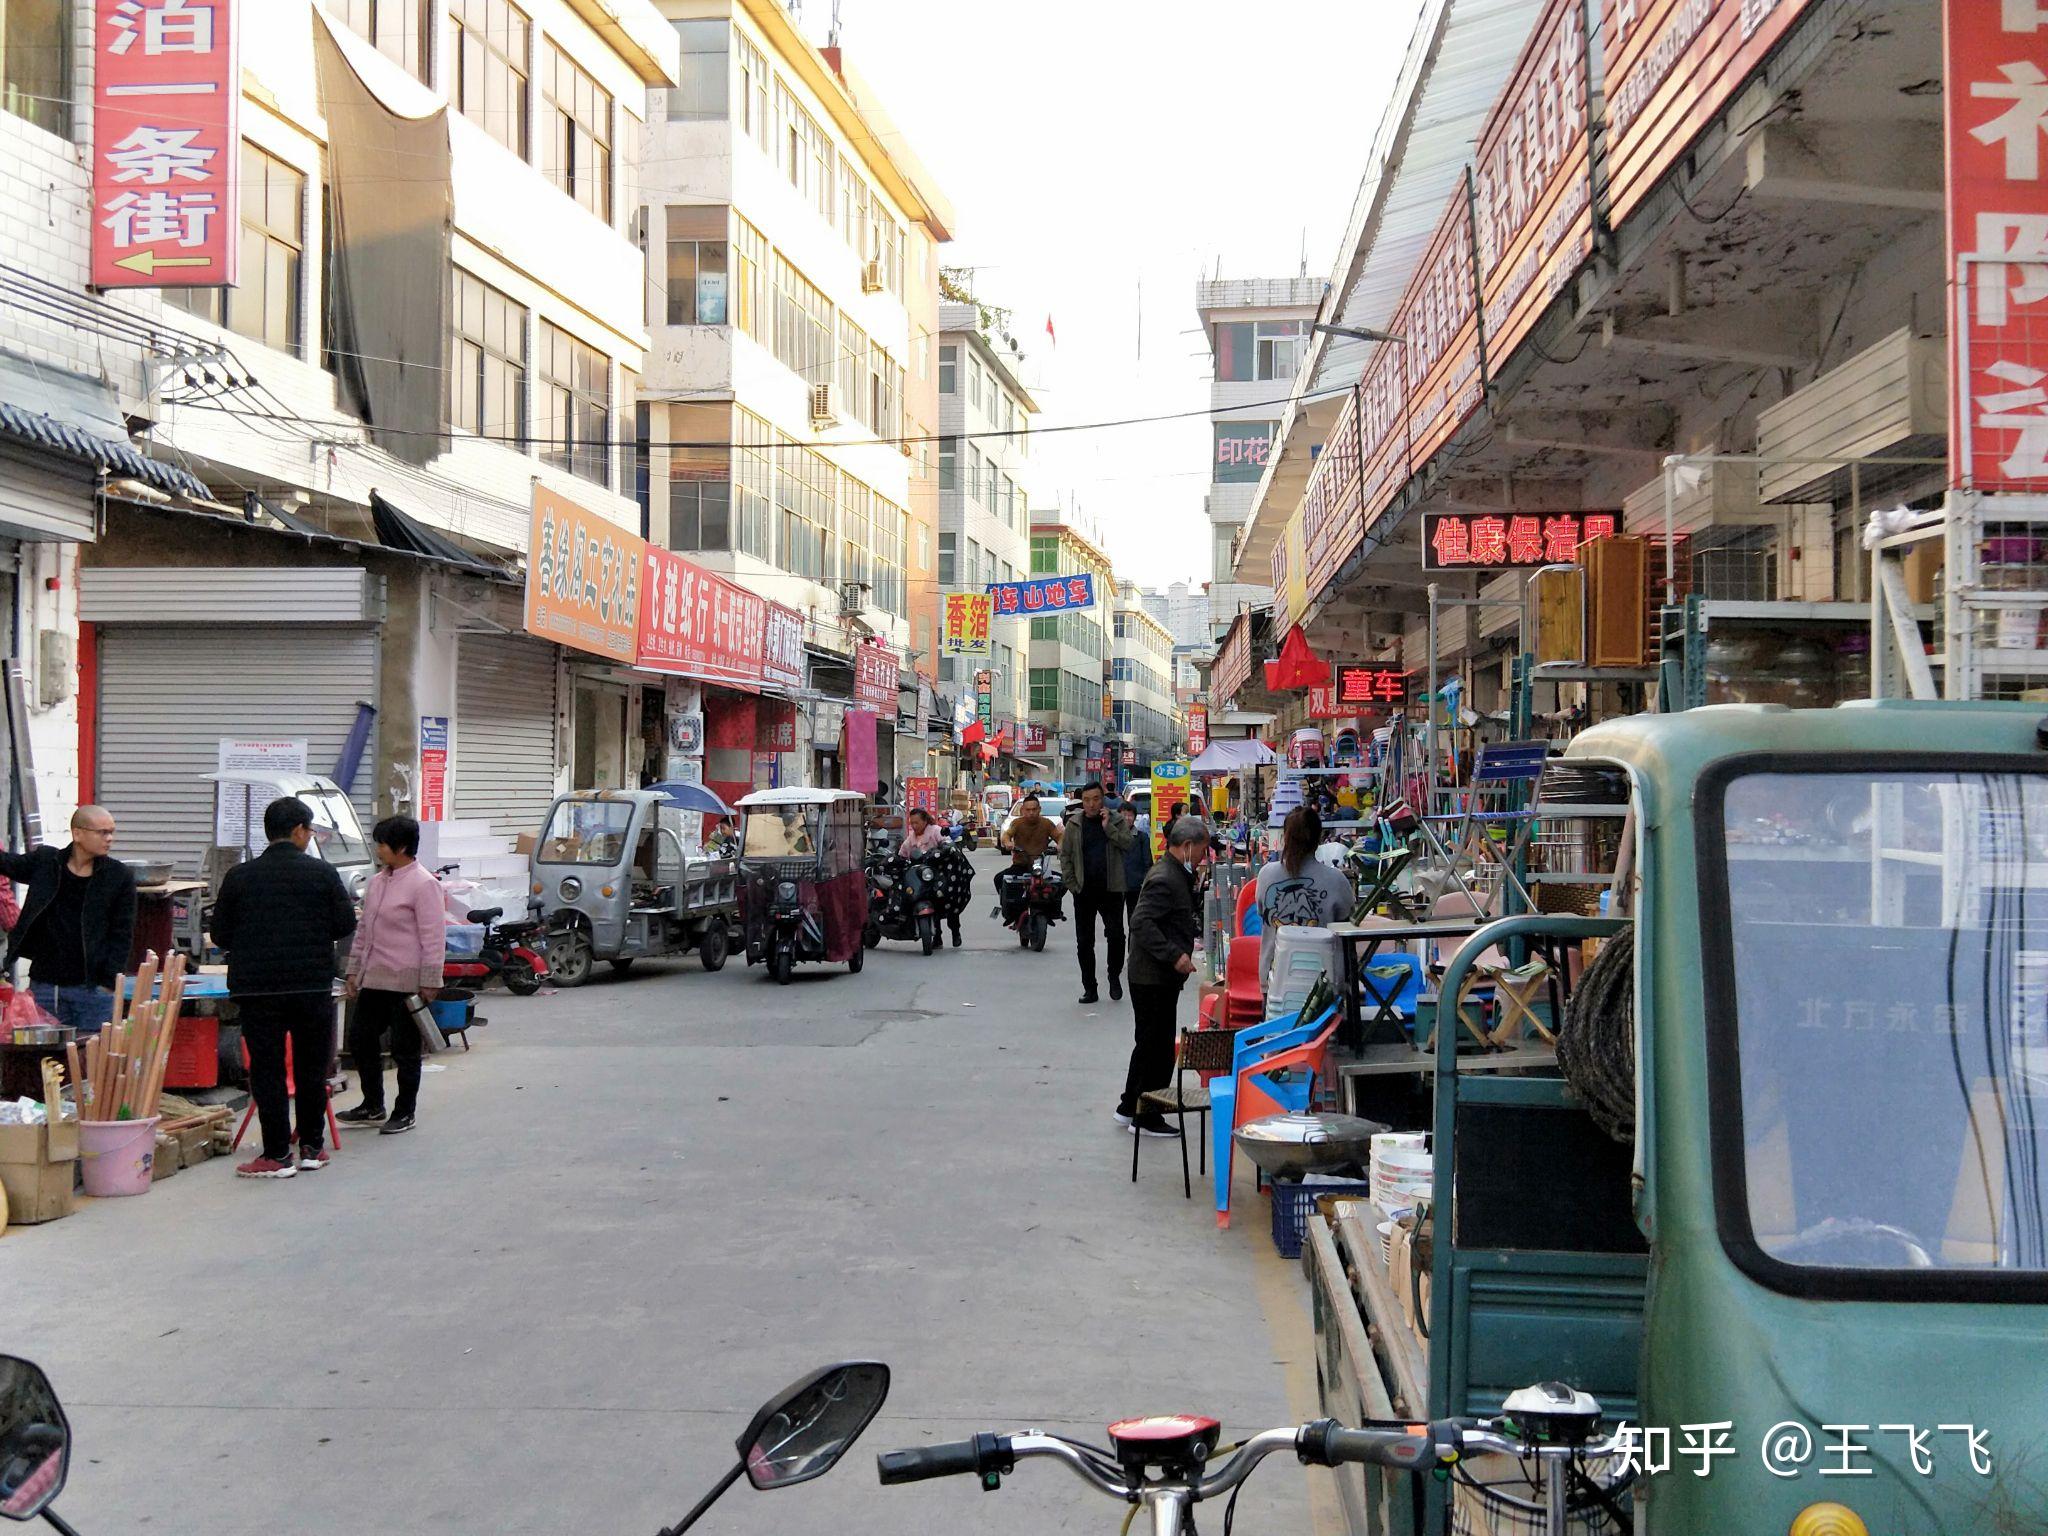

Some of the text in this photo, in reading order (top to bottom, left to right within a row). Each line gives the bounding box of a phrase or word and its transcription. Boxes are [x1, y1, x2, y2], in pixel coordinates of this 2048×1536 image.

[1217, 437, 1269, 466] 印花
[648, 554, 709, 644] 飞越纸行
[946, 637, 988, 649] 批发
[1342, 669, 1405, 702] 童车
[1189, 714, 1206, 753] 超市
[908, 779, 937, 790] 天一行
